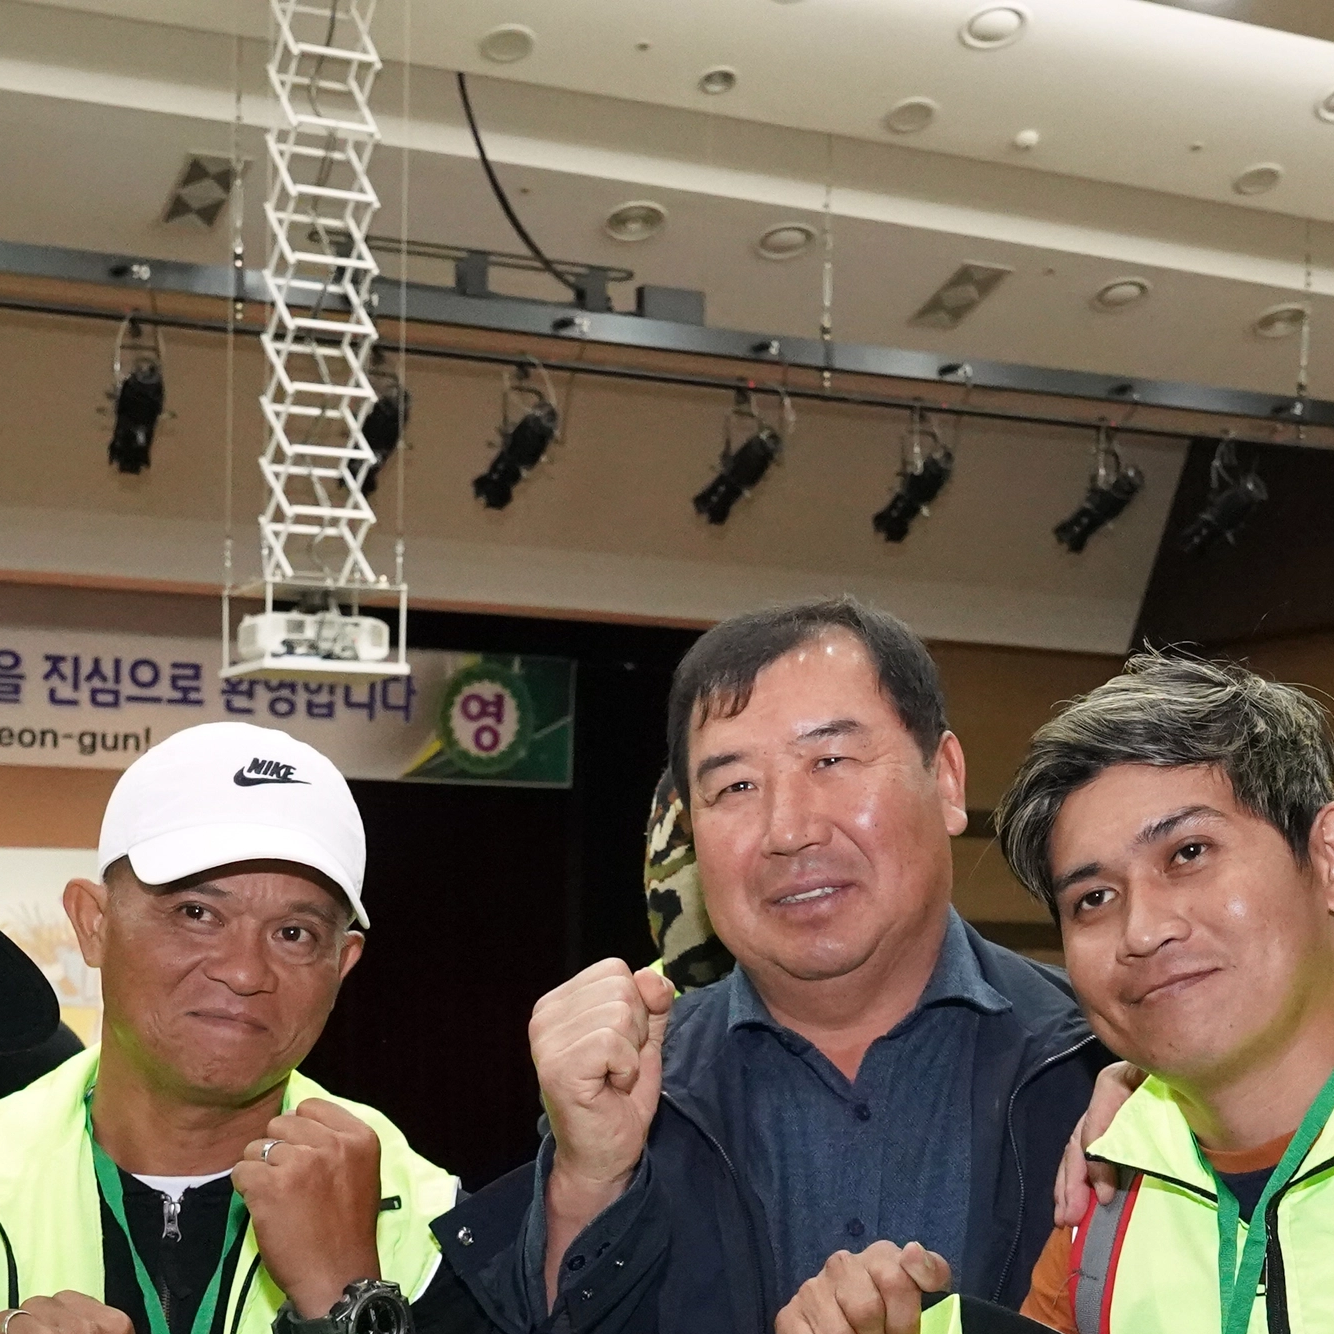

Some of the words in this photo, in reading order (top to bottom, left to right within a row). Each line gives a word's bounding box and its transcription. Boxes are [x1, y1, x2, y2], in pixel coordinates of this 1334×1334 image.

[42, 652, 205, 708] 진심으로
[461, 692, 505, 754] 영
[246, 757, 296, 781] NIKE
